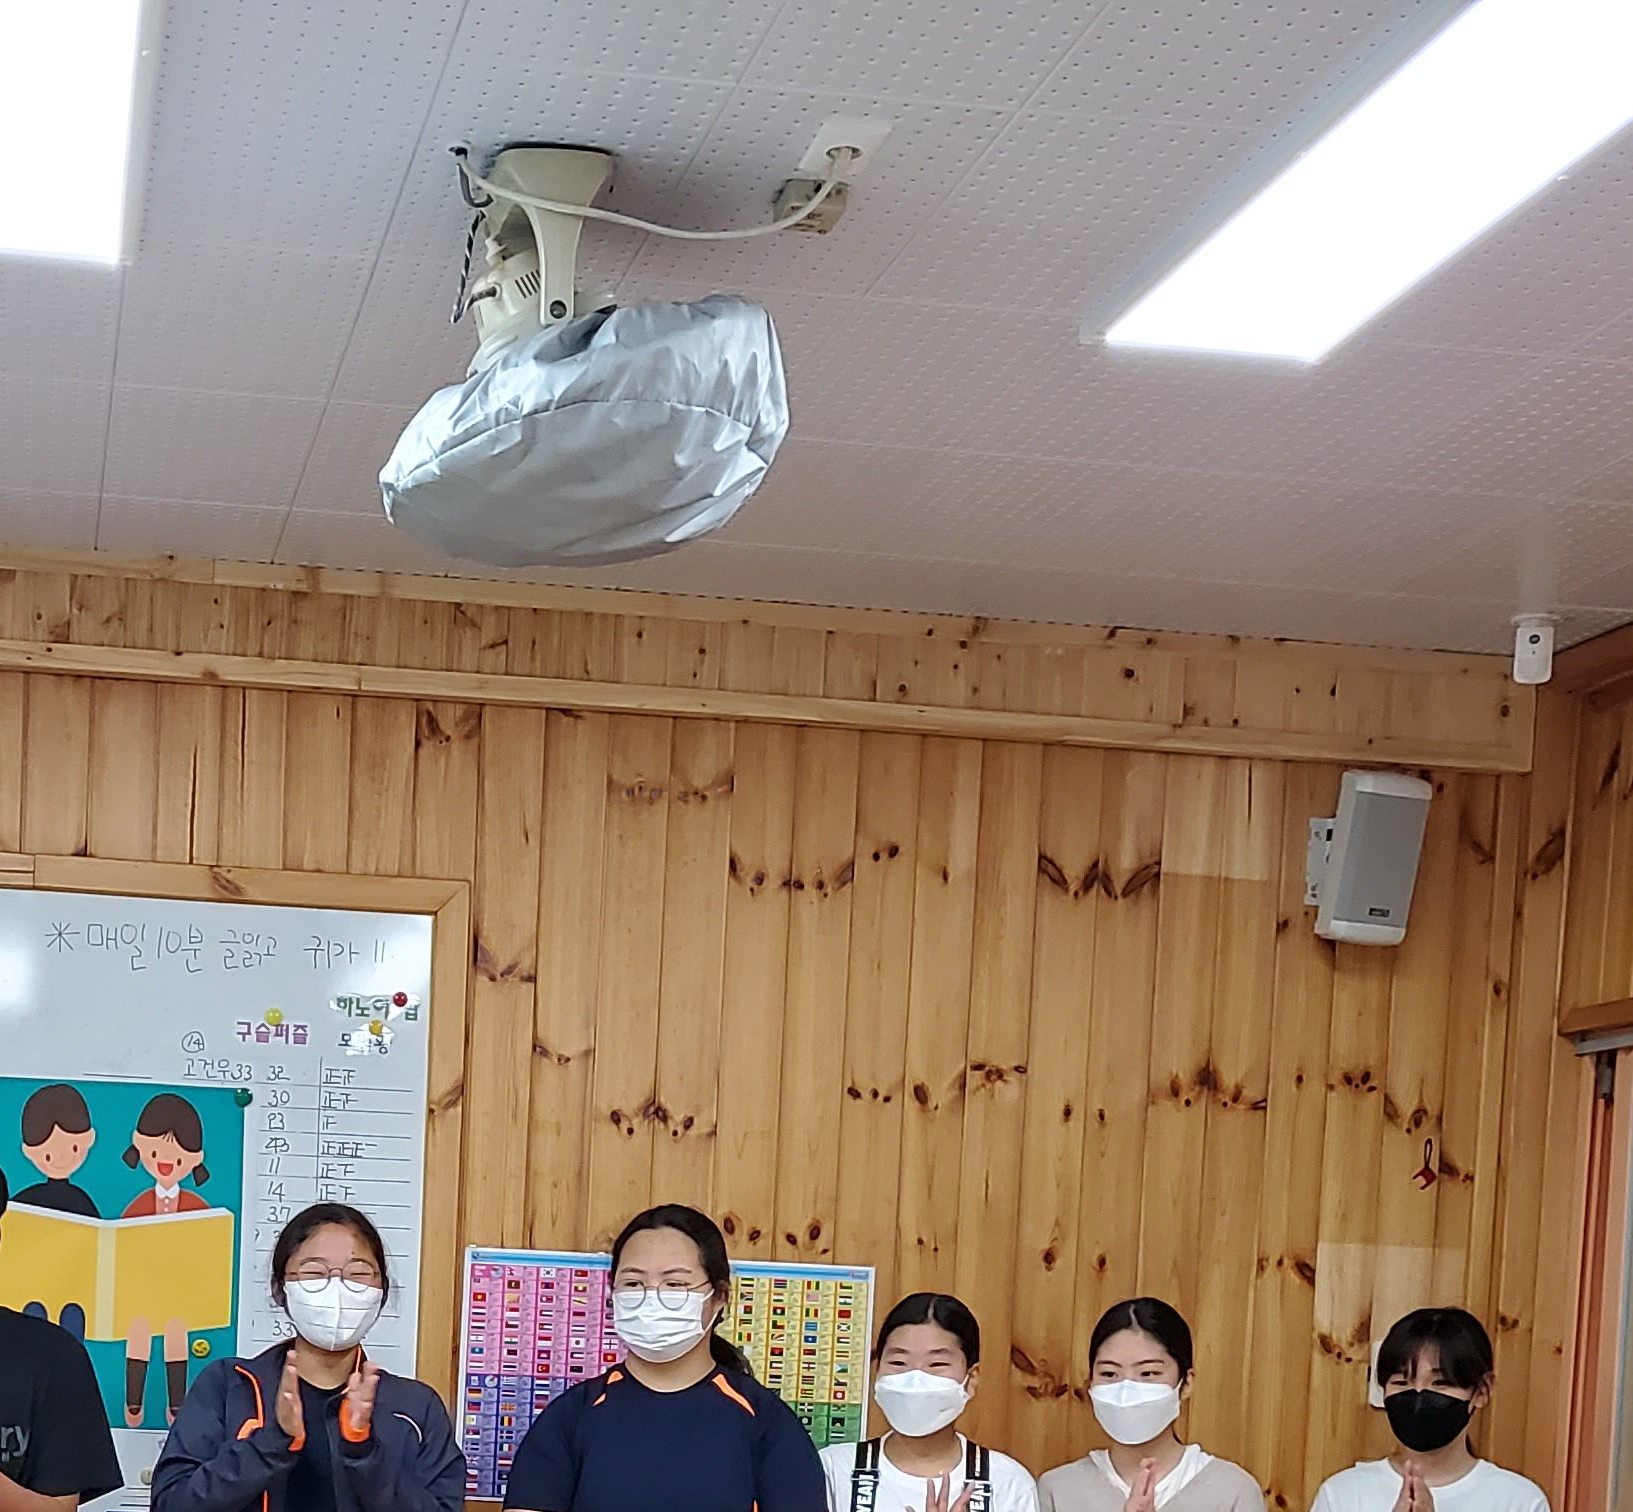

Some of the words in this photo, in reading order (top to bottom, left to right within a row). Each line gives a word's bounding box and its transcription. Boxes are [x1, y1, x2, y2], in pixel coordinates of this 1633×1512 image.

[86, 922, 147, 971] 매일
[235, 1020, 309, 1046] 구슬퍼즐
[267, 1090, 291, 1107] 30
[268, 1183, 286, 1203] 14
